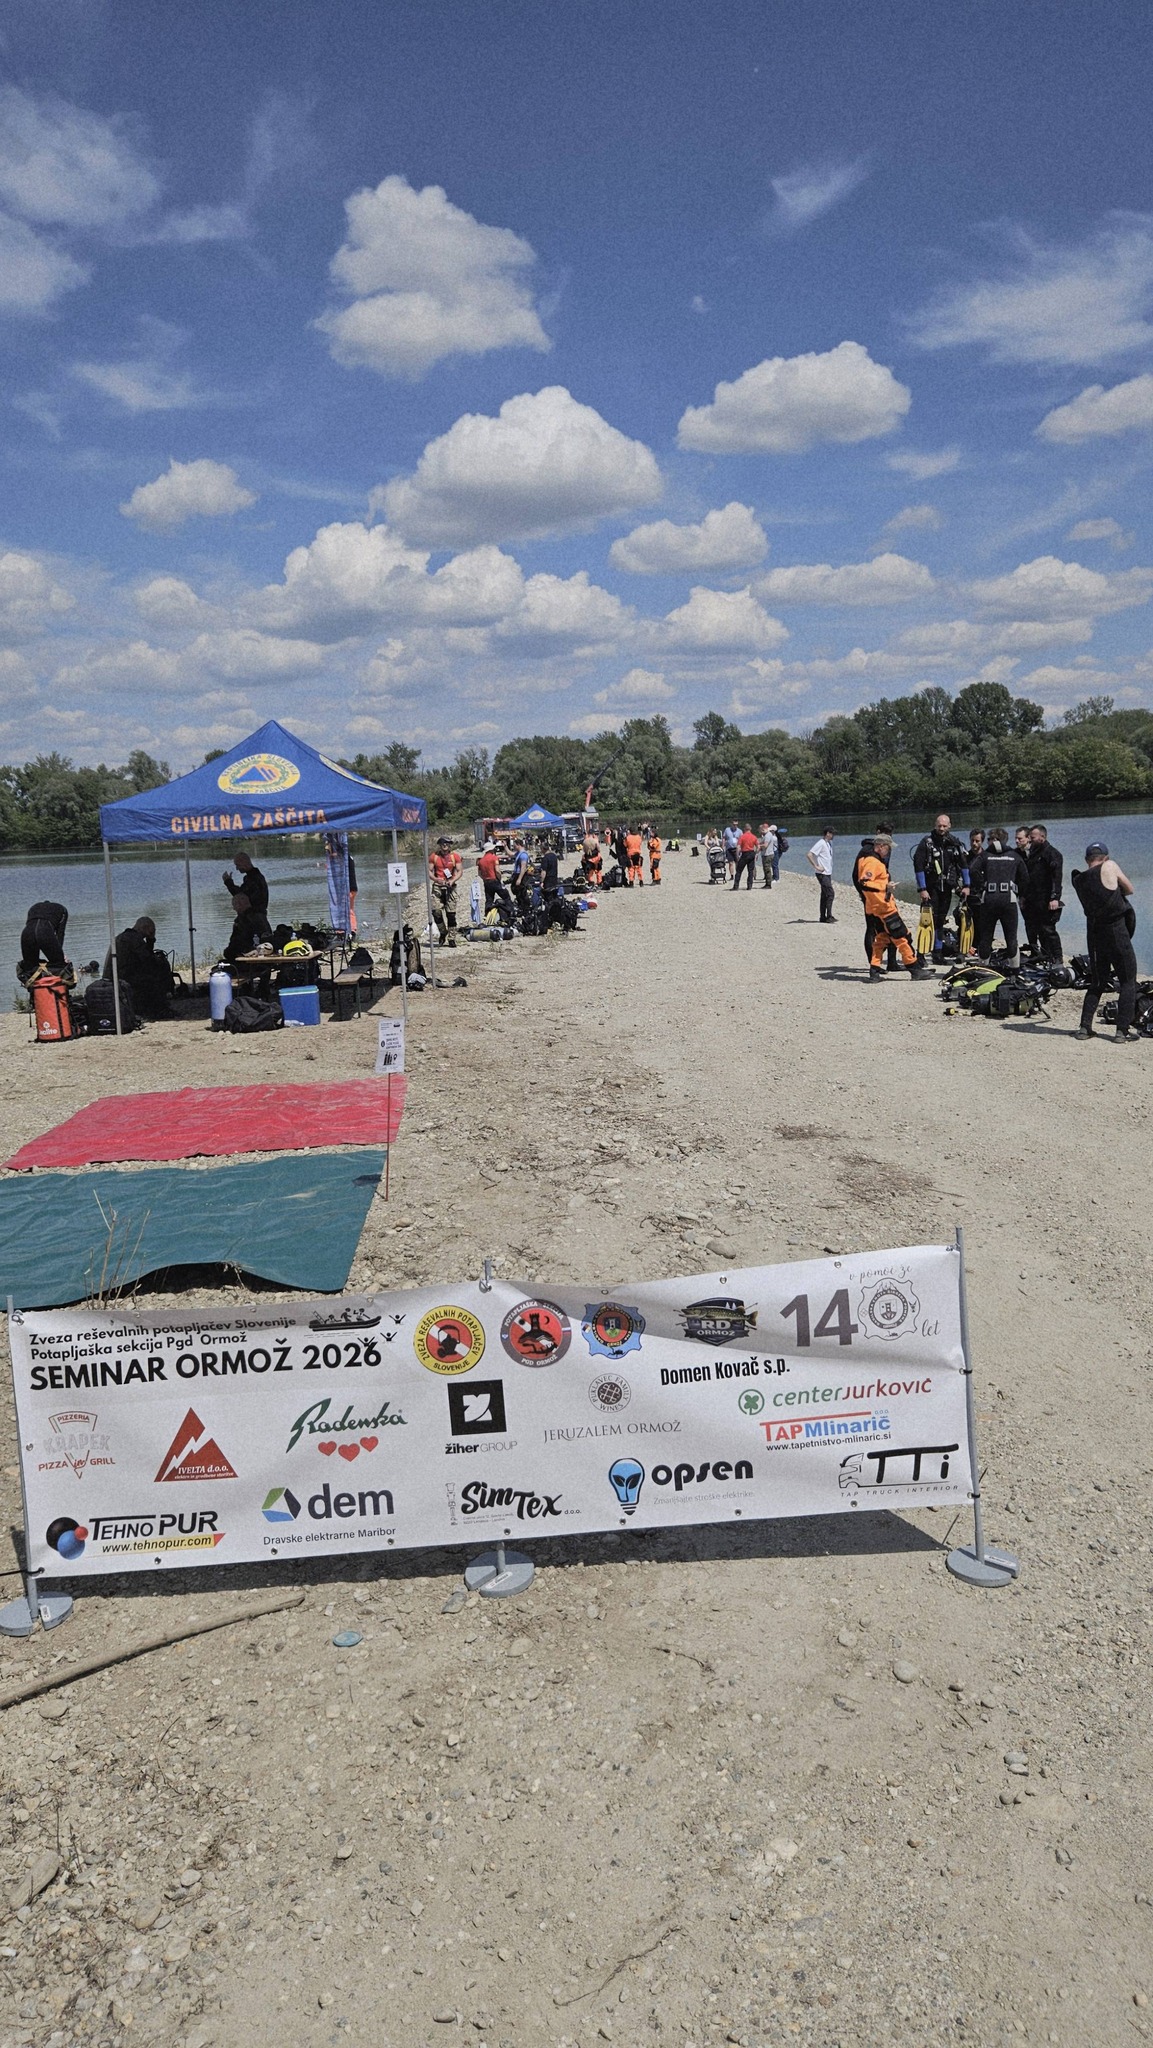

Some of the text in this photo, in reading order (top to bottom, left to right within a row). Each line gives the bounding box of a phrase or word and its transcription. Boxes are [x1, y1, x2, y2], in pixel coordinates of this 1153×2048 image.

[171, 808, 328, 834] CIVILNA ZAŠČITA
[504, 1301, 538, 1327] POTAPLJAŠKA
[701, 1320, 731, 1330] RD
[780, 1288, 859, 1347] 14
[29, 1317, 297, 1345] Zveza reševalnih potapljačev Slovenije
[417, 1309, 483, 1361] ZVEZA REŠEVALNIH POTAPLJAČEV
[922, 1319, 942, 1337] let
[31, 1331, 248, 1361] Potapljaška sekcija Pgd Ormož
[30, 1337, 382, 1390] SEMINAR ORMOŽ 2026
[433, 1359, 470, 1371] SLOVENIJE
[660, 1356, 790, 1386] Domen Kovač s.p.
[57, 1414, 90, 1422] PIZZERIA
[600, 1403, 624, 1412] WINES
[286, 1397, 408, 1453] Radenska
[543, 1419, 682, 1443] JERUZALEM ORMOŽ
[766, 1432, 891, 1451] www.tapetnistvo-mlinaric.si
[38, 1460, 68, 1471] PIZZA
[90, 1457, 116, 1466] GRILL
[178, 1464, 228, 1474] IVELTA d.o.o.
[651, 1460, 754, 1491] opsen
[907, 1485, 958, 1493] INTERIOR
[307, 1483, 394, 1520] dem
[102, 1536, 211, 1553] www.tehnopur.com
[263, 1527, 396, 1545] Dravske elektrarne Maribor
